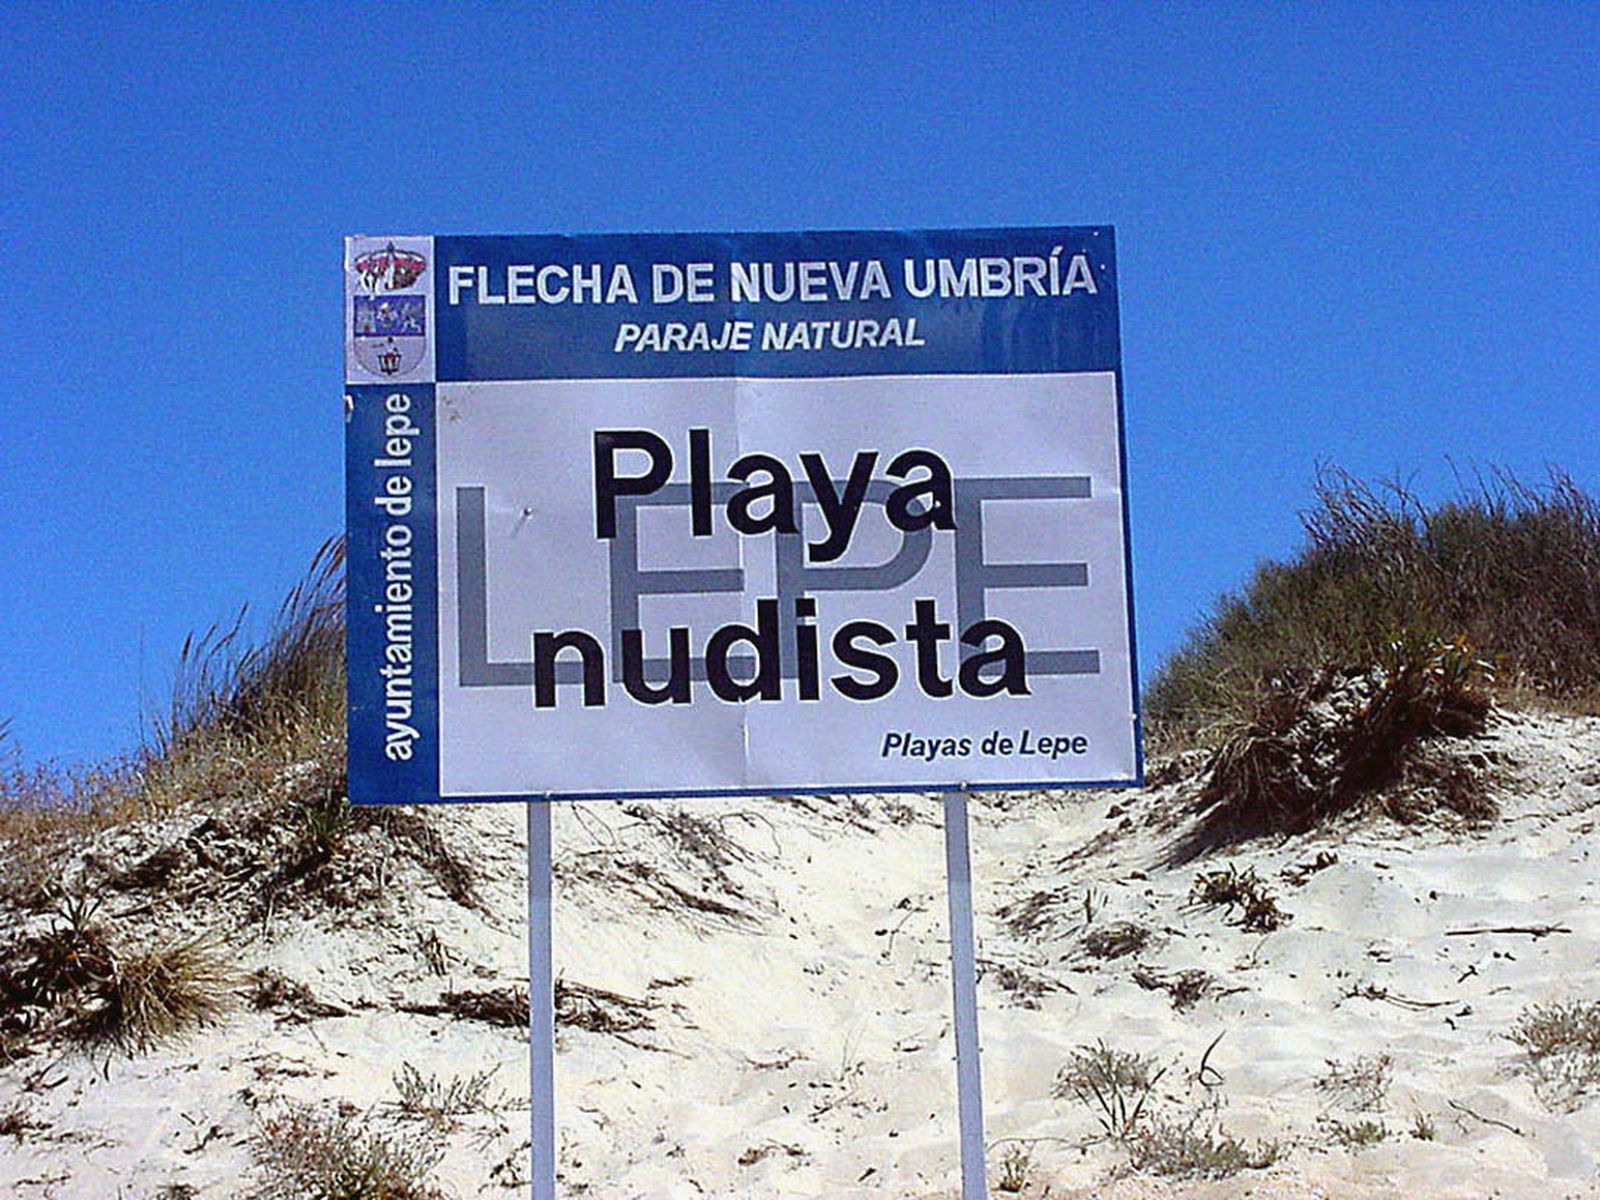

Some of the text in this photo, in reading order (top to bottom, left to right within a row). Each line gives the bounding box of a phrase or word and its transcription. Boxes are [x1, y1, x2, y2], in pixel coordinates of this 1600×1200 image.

[448, 246, 1098, 305] FLECHA DE NUEVA UMBRÍA
[614, 317, 926, 352] PARAJE NATURAL
[594, 428, 958, 562] Playa
[374, 393, 420, 761] ayuntamiento de lepe
[533, 597, 1031, 707] nudista
[881, 730, 1088, 761] Playas de Lepe
